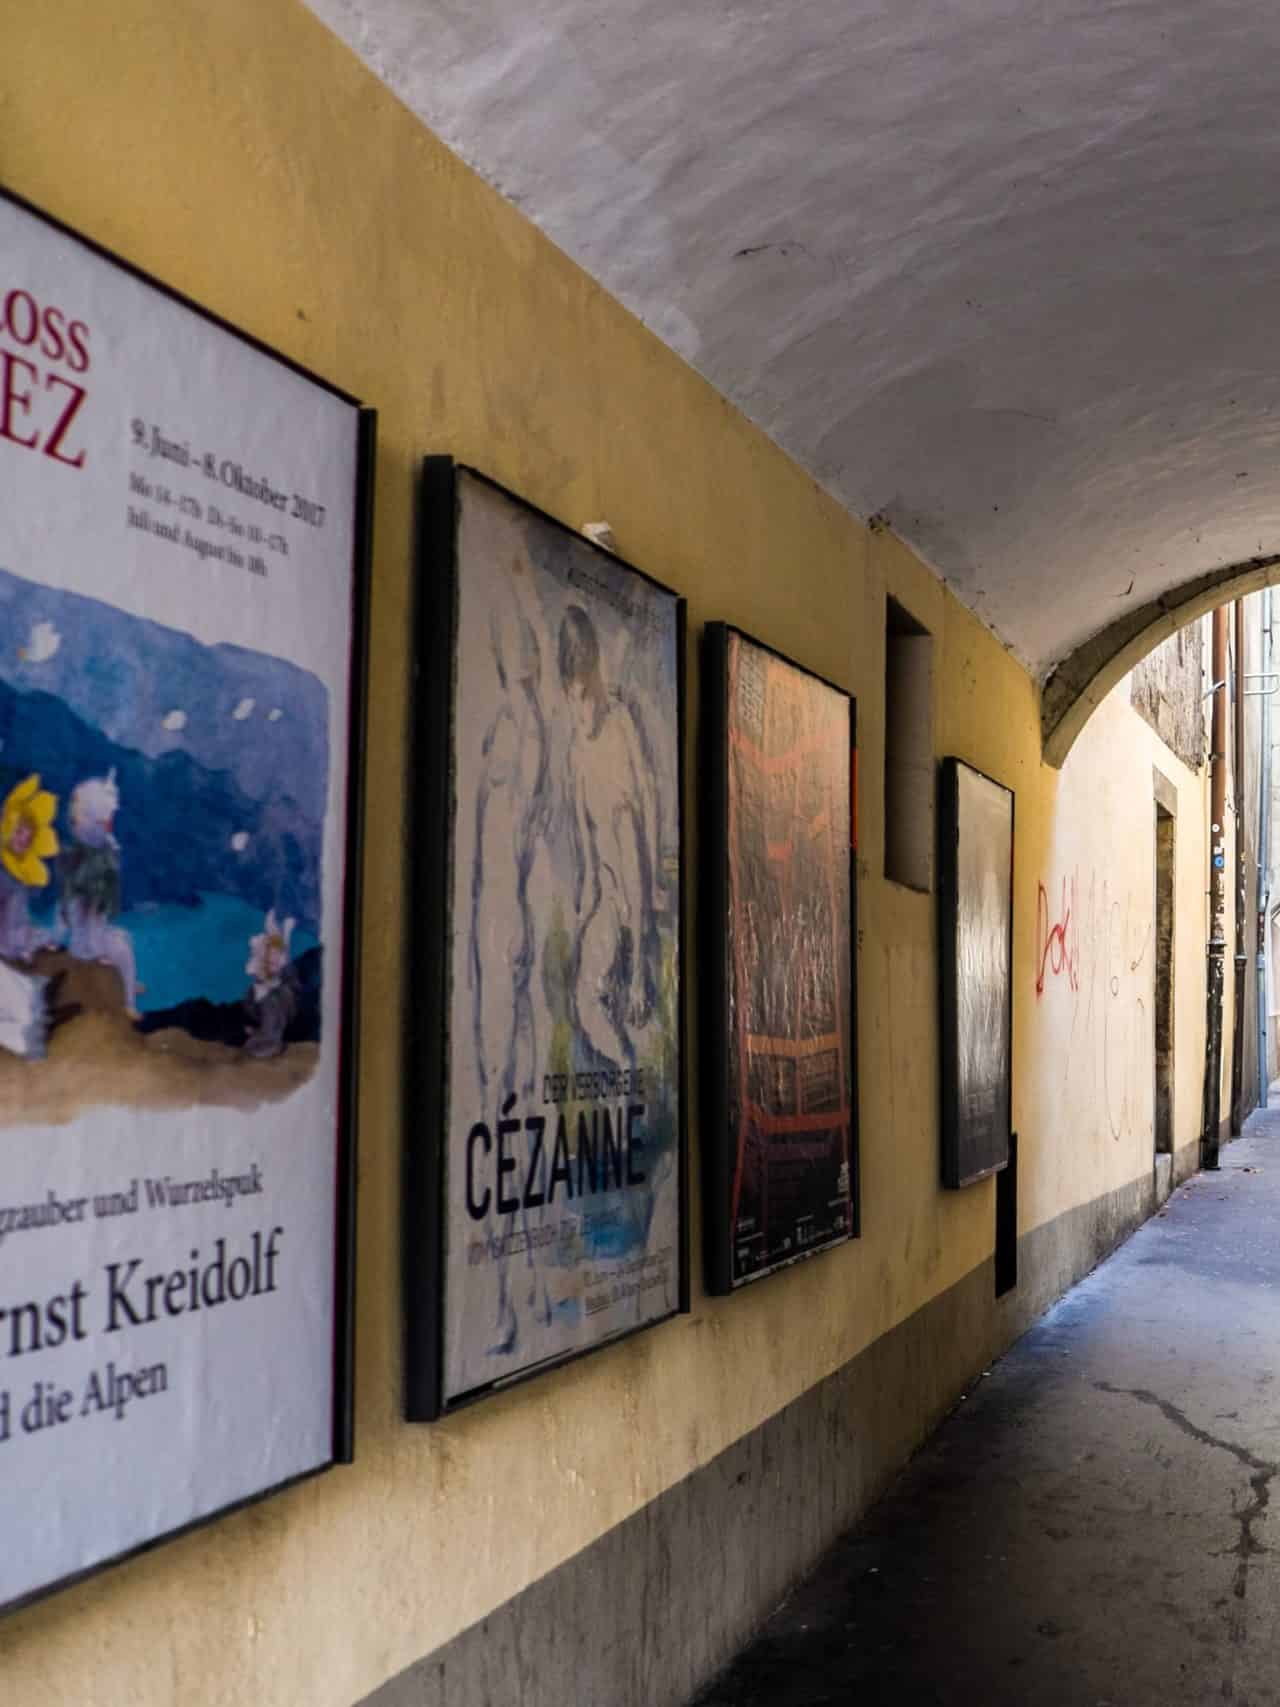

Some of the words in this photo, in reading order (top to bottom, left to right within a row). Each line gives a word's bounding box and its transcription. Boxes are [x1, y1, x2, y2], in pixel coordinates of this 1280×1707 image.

[0, 288, 90, 373] OSS
[93, 1179, 138, 1218] und
[466, 1092, 646, 1221] CÉZANNE
[0, 1280, 90, 1357] nst
[104, 1226, 285, 1333] Kreidolf
[21, 1381, 73, 1434] die
[80, 1362, 168, 1420] Alpen
